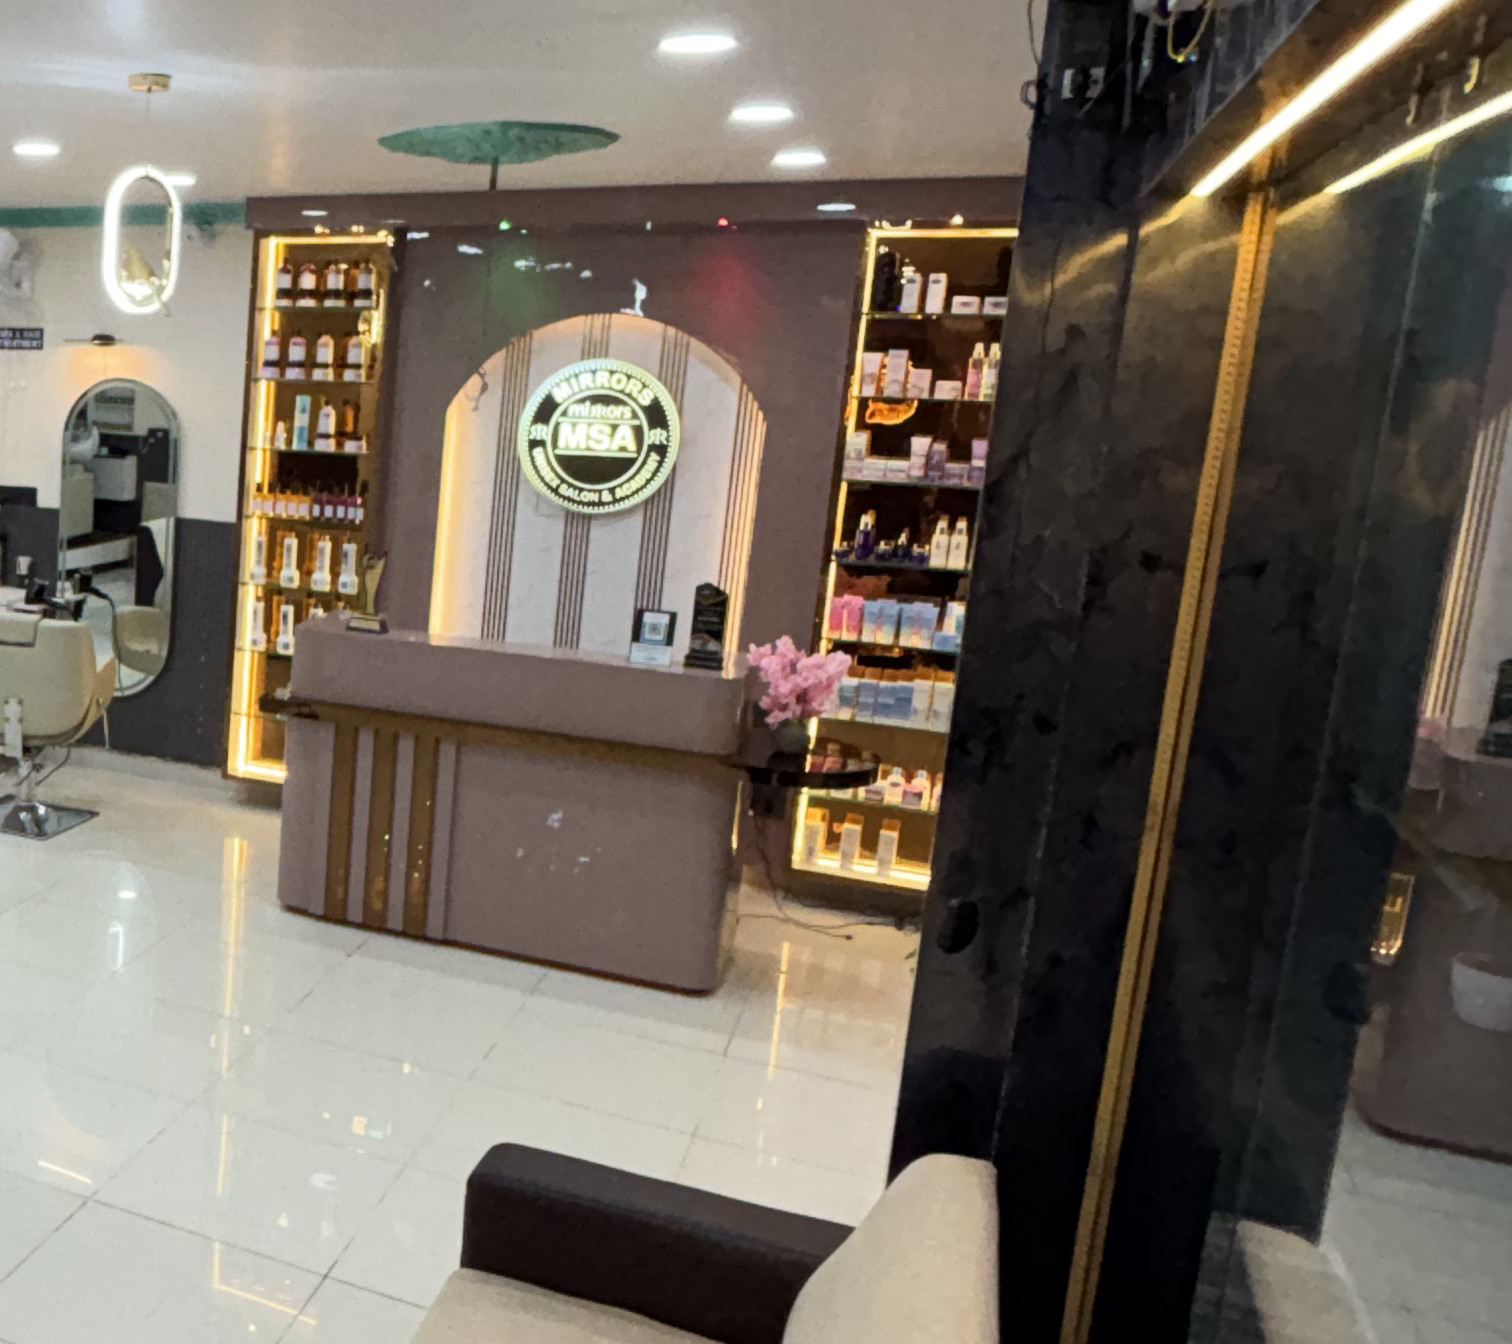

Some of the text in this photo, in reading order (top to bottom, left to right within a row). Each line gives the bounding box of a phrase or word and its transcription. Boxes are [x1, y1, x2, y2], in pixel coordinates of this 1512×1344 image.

[551, 370, 655, 406] MIRRORS
[557, 422, 638, 452] MSA
[531, 446, 561, 489] UNISEX
[557, 483, 599, 503] SALON
[615, 451, 661, 499] ACADEMY
